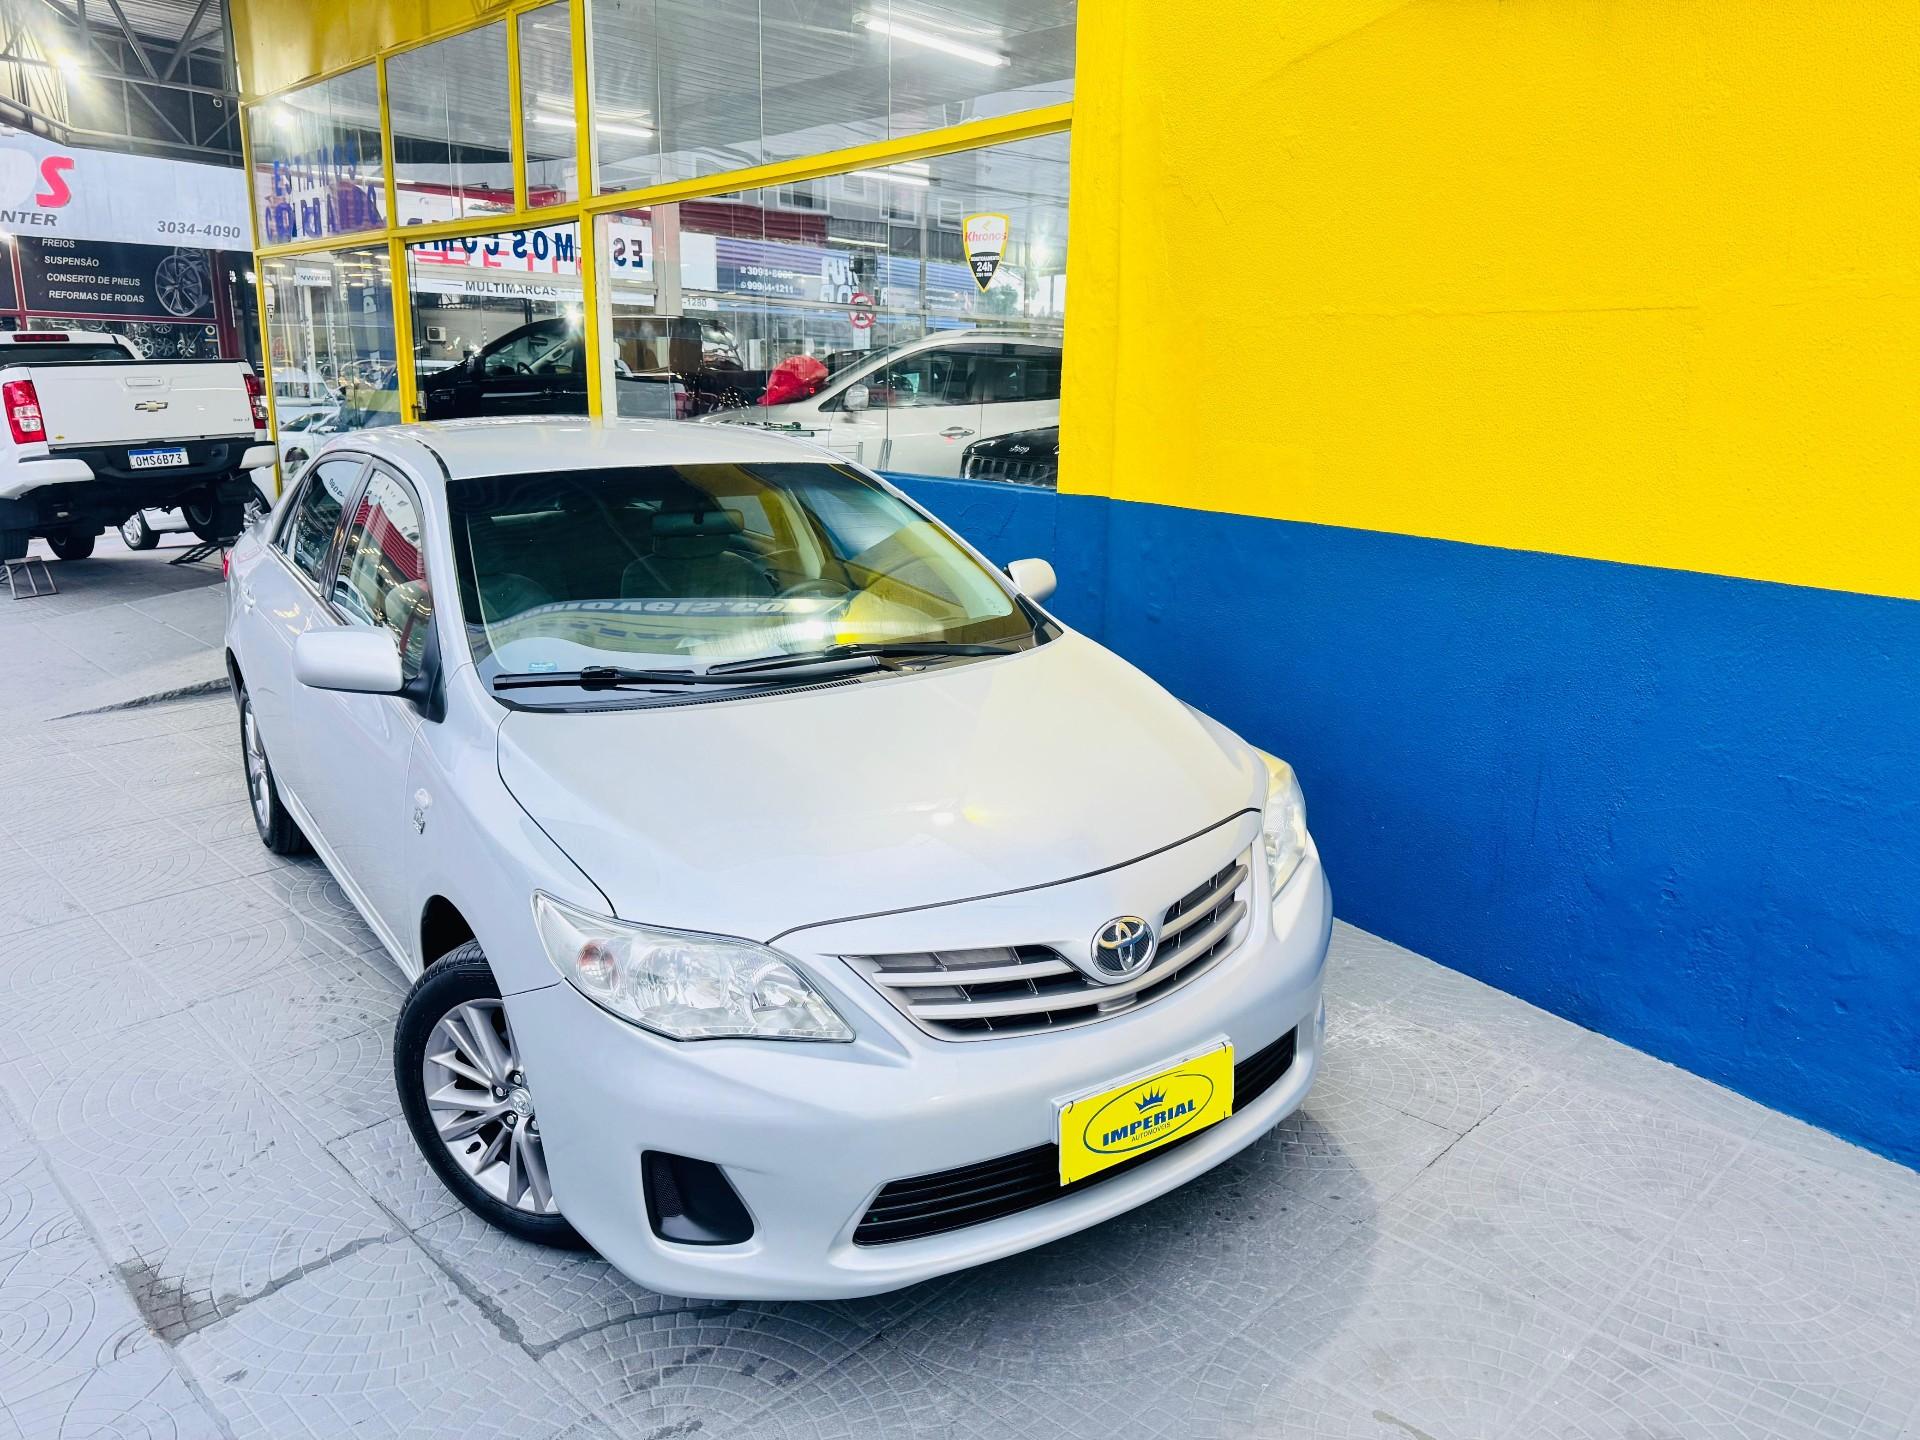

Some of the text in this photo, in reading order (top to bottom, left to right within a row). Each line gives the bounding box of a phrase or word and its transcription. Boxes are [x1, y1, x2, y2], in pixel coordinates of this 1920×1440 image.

[157, 220, 241, 239] 3034-4090
[965, 231, 1007, 242] Khronos
[41, 238, 75, 248] FREIOS
[44, 255, 99, 267] SUSPENSÃO
[976, 262, 993, 272] 24h
[46, 273, 141, 286] CONSERTO DE PNEUS
[465, 280, 559, 296] MULTIMARCAS
[48, 290, 145, 302] REFORMAS DE RODAS
[135, 454, 182, 467] OMS6B73
[1102, 1099, 1197, 1147] IMPERIAL
